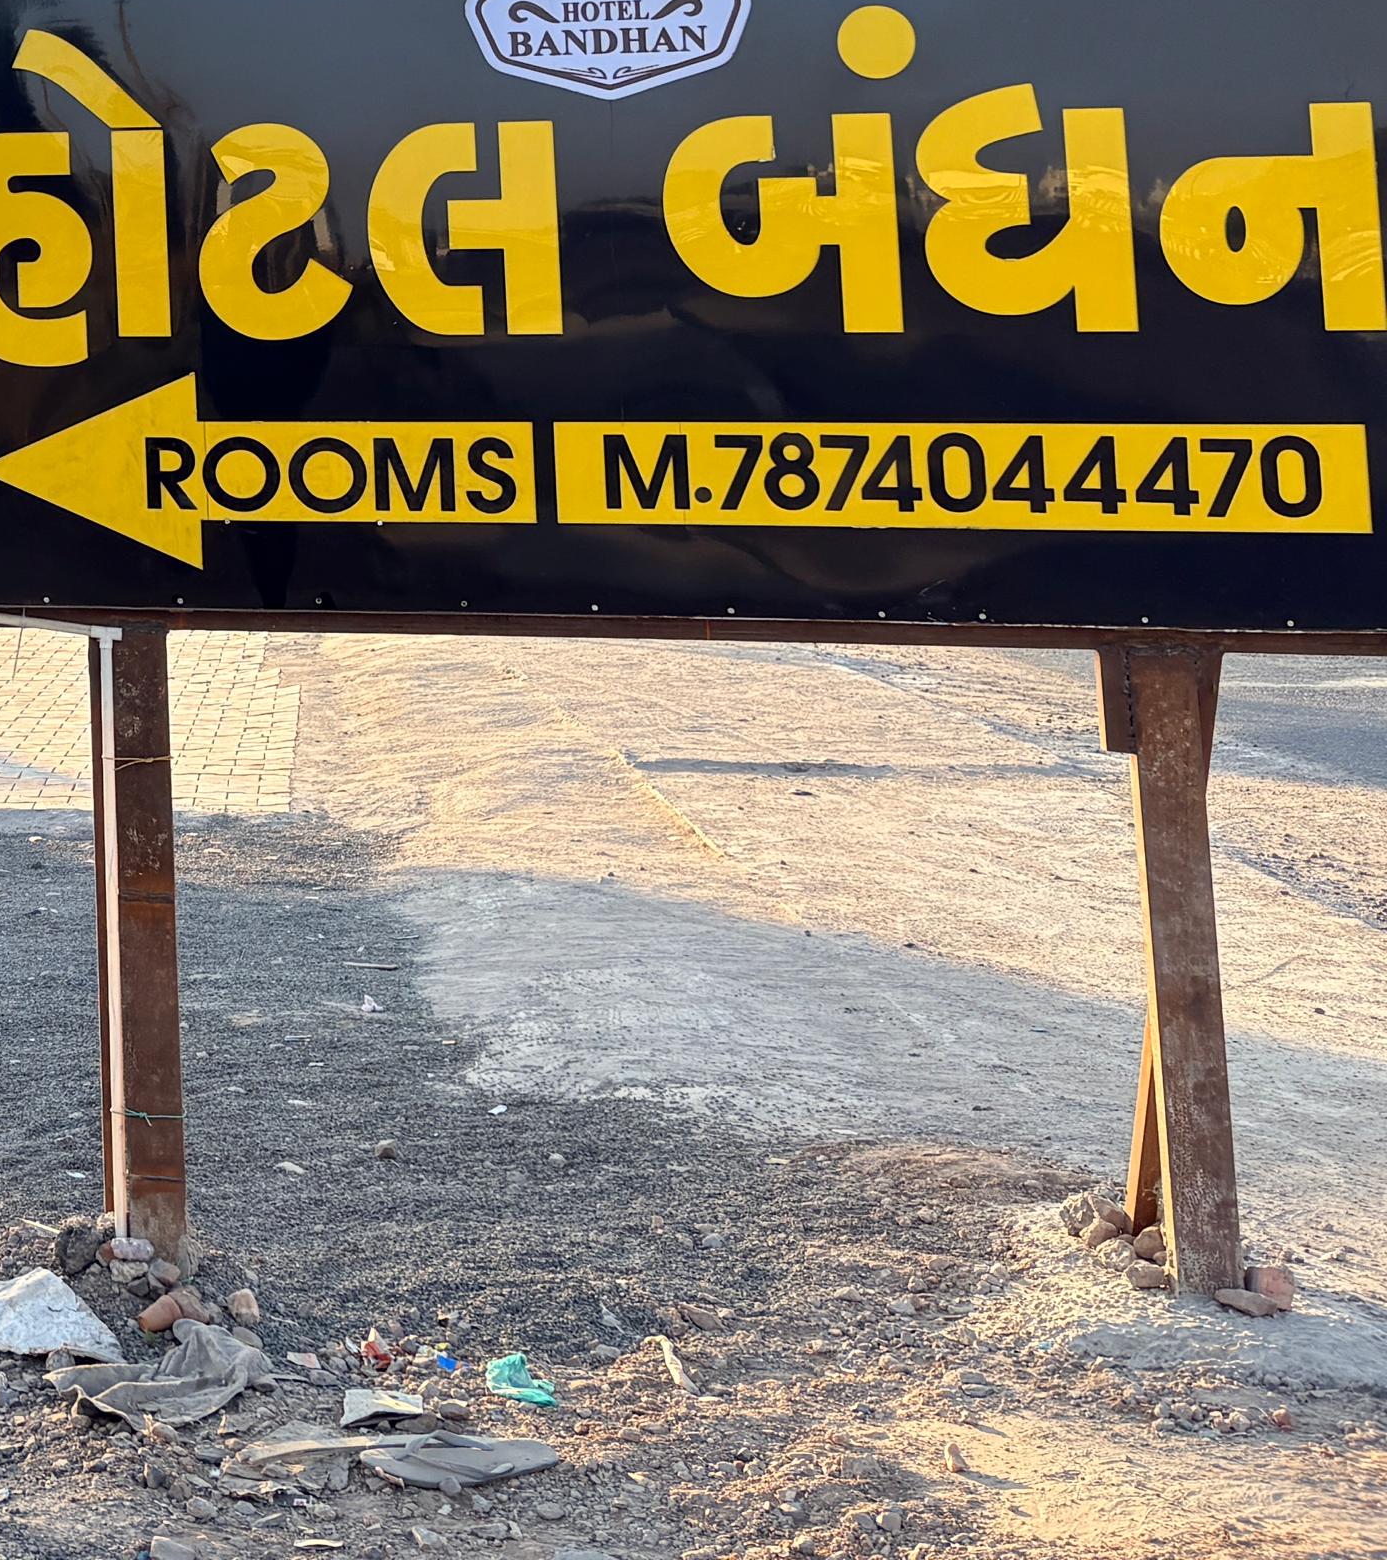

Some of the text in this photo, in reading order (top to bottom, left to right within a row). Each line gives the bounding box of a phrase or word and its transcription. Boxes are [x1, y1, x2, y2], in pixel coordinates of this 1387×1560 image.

[562, 0, 649, 22] HOTEL
[508, 25, 707, 57] BANDHAN
[663, 5, 1387, 333] બંધન
[146, 432, 1324, 517] ROOMS M.7874044470
